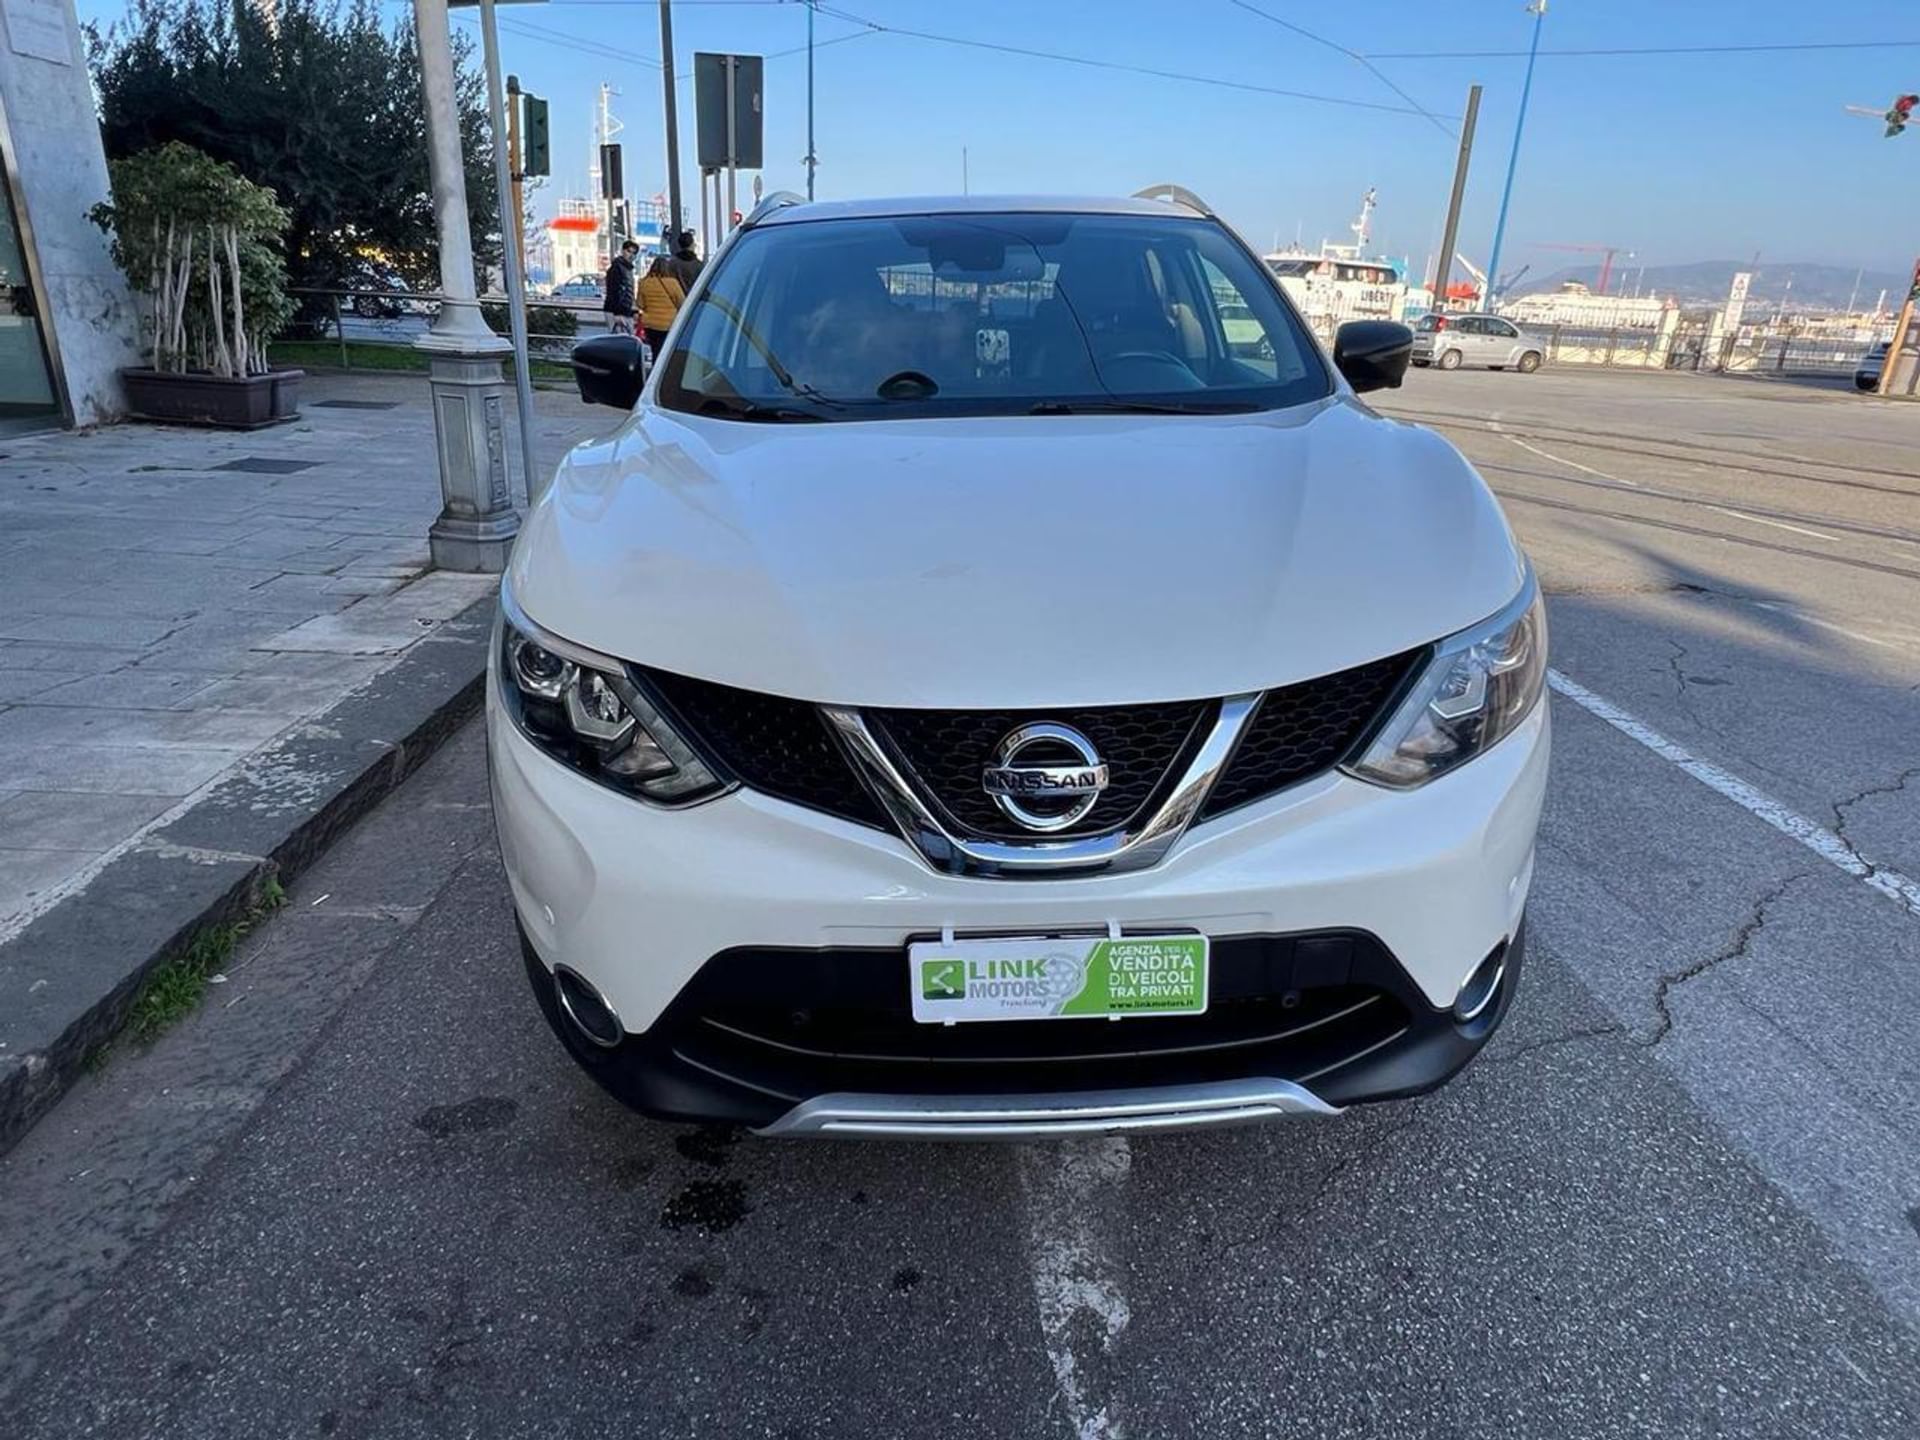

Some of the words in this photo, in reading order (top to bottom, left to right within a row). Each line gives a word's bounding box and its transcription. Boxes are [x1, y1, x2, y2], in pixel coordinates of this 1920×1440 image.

[997, 771, 1096, 789] NISSAN
[1109, 945, 1161, 956] AGENZIA
[969, 960, 1048, 979] LINK
[1109, 954, 1194, 971] VENDITA
[1109, 972, 1125, 986] DI
[1129, 970, 1194, 985] VEICOLI
[969, 981, 1050, 998] MOTORS
[1109, 986, 1136, 998] TRA
[1140, 985, 1194, 997] PRIVATI
